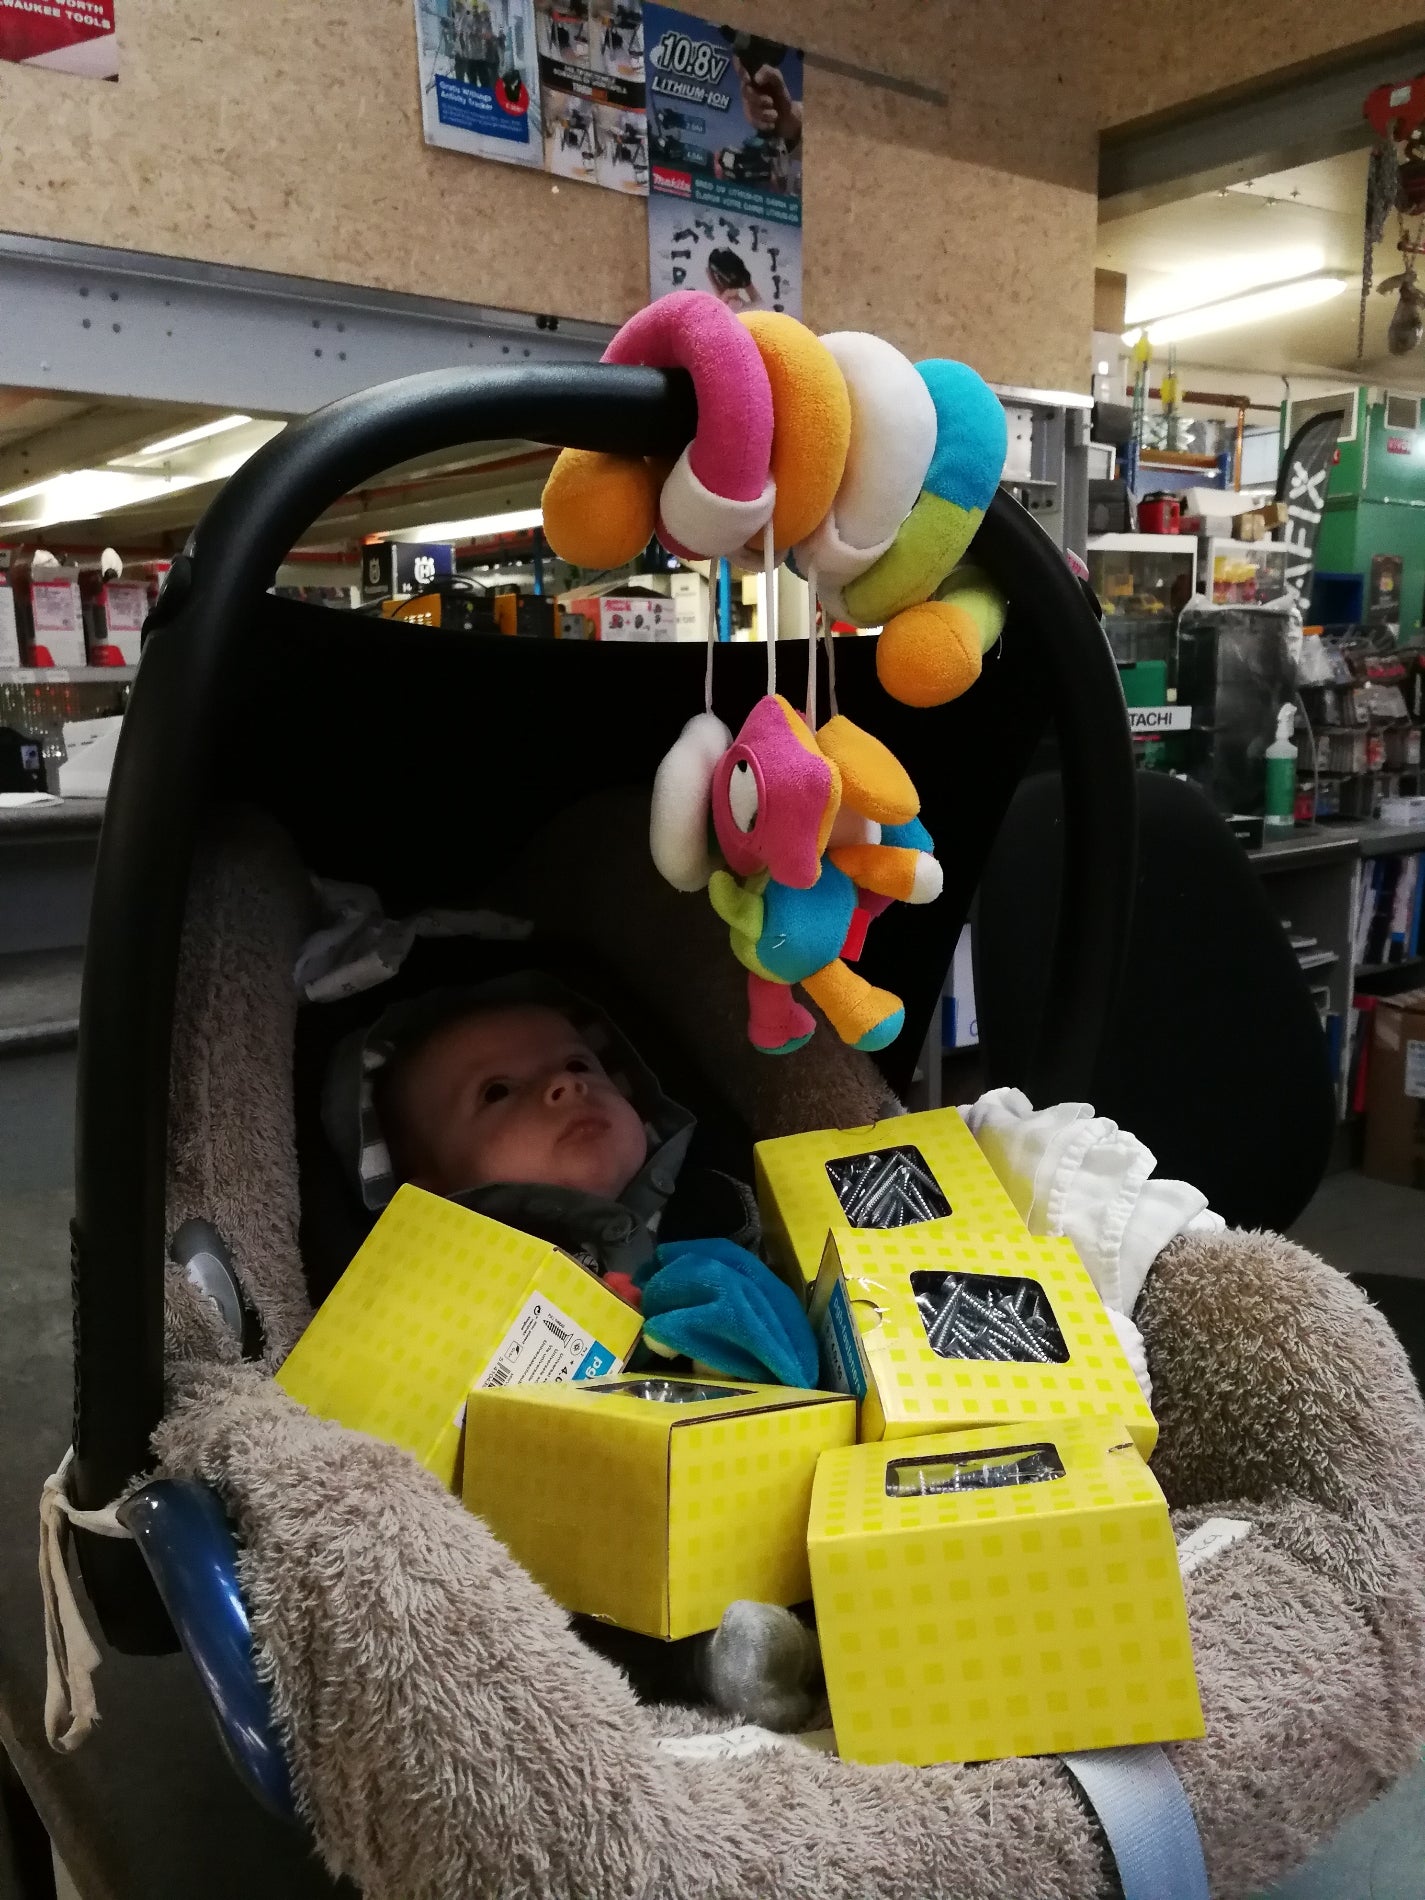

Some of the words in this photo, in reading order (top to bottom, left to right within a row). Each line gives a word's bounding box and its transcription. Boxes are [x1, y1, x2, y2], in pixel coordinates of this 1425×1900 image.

[65, 10, 110, 29] TOOLS
[652, 76, 730, 109] LITHIUM-ION
[547, 1352, 565, 1378] Universal
[584, 1356, 604, 1380] pg
